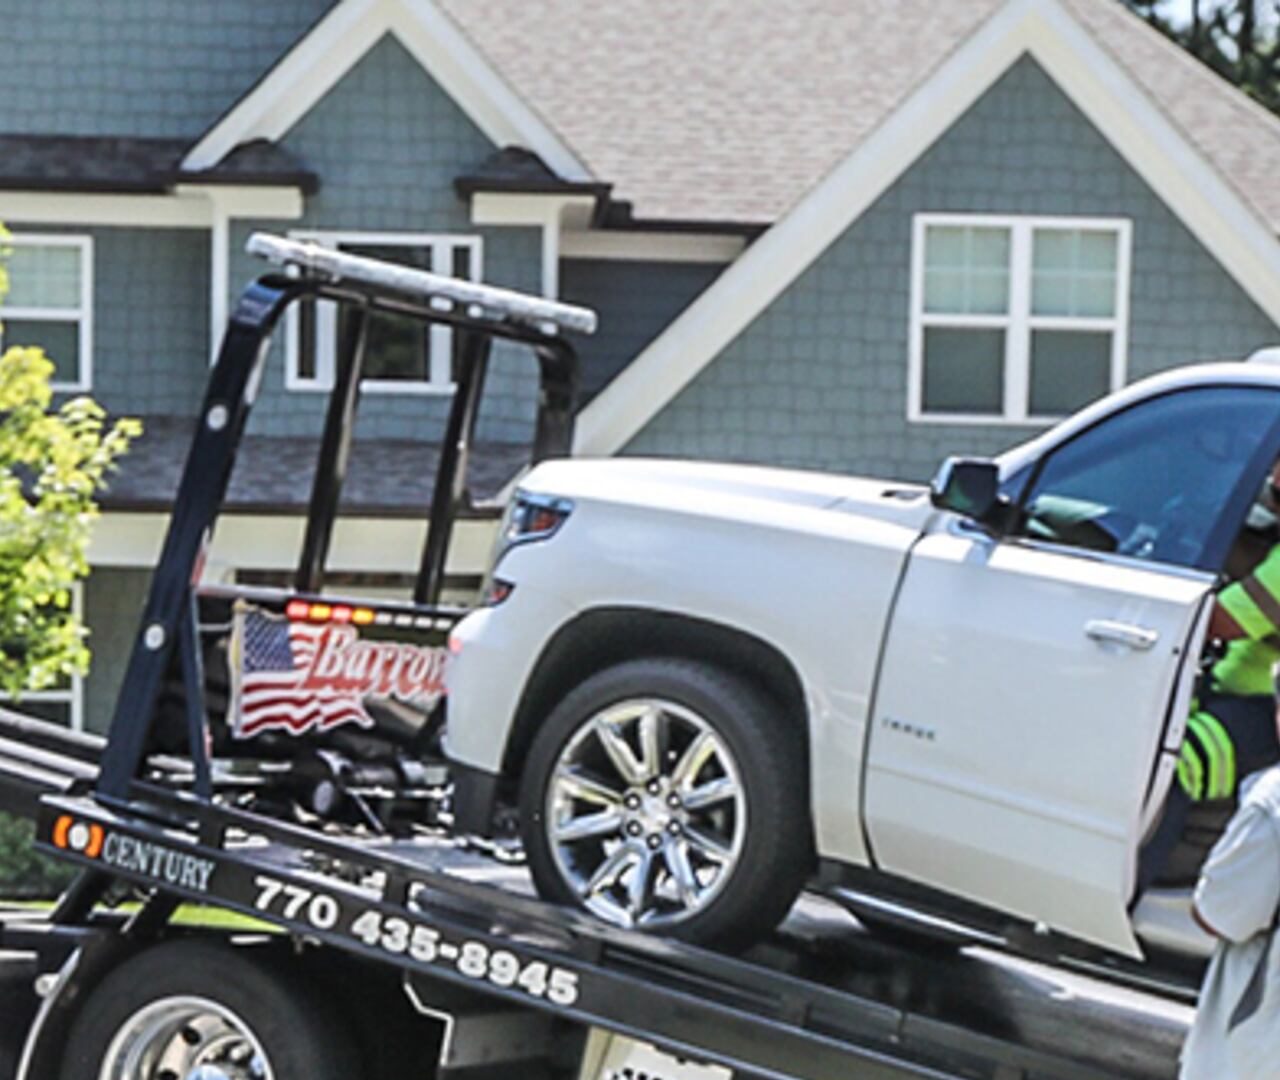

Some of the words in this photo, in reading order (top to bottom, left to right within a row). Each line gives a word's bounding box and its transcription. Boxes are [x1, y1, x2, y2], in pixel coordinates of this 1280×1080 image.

[103, 832, 215, 891] CENTURY
[254, 875, 338, 929] 770
[351, 910, 578, 1004] 435-8945
